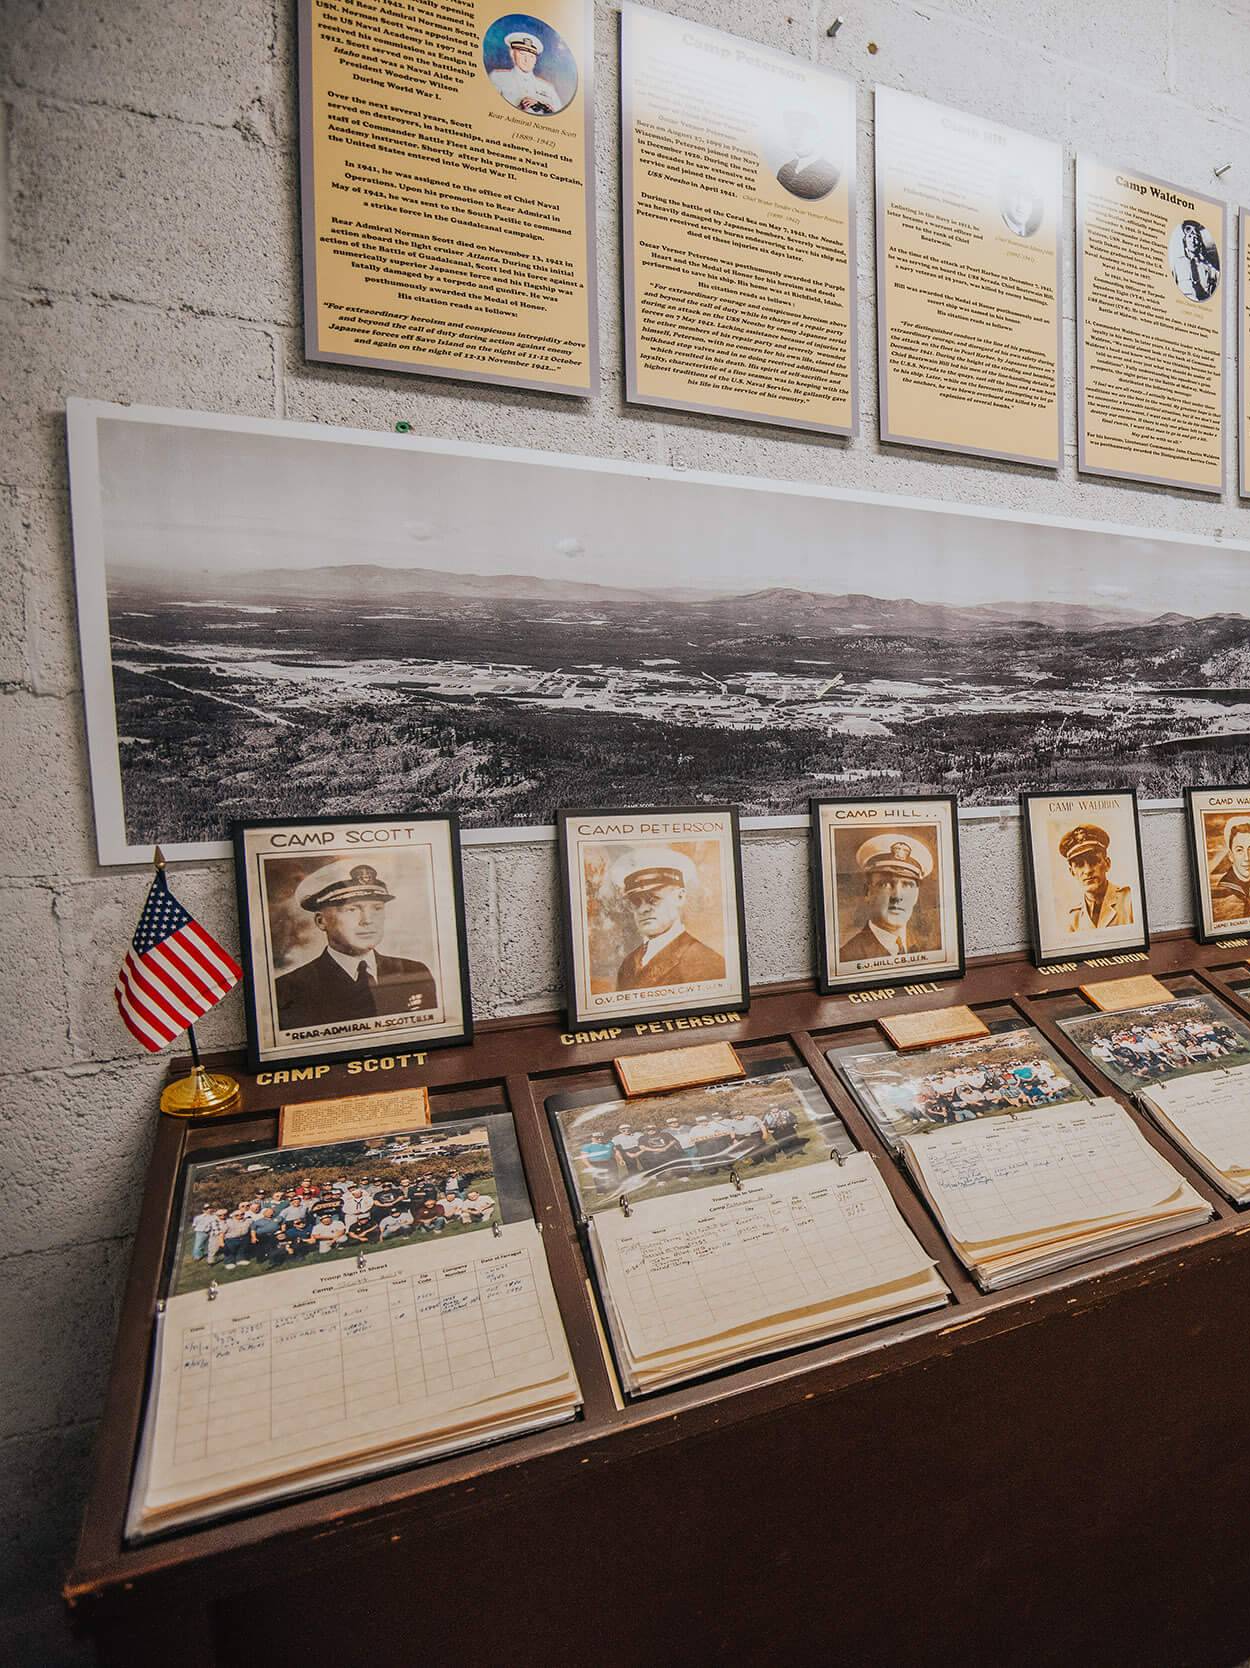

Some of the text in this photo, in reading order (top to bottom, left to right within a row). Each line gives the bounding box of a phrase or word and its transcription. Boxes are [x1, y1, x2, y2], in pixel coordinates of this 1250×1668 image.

[322, 12, 473, 57] the US Naval Academy in 1907 and
[338, 57, 459, 93] President Woodrow Wilson
[352, 73, 442, 101] During World War I.
[487, 111, 577, 138] Rear Admiral Norman Scott
[327, 123, 583, 187] Academy instructor. Shortly after his promotion to Captain,
[647, 170, 662, 178] USS
[663, 174, 690, 185] Neosho
[699, 183, 718, 192] April
[720, 189, 737, 198] 1941.
[1115, 176, 1196, 211] Camp Waldron
[686, 230, 702, 238] died
[712, 236, 730, 244] these
[732, 240, 758, 251] injuries
[770, 249, 785, 257] days
[786, 252, 803, 262] later.
[639, 240, 660, 250] Oscar
[661, 244, 686, 255] Verner
[688, 251, 718, 262] Peterson
[734, 262, 781, 277] posthumously
[783, 274, 811, 283] awarded
[824, 282, 845, 291] Purple
[397, 291, 412, 300] His
[413, 295, 448, 306] citation
[449, 302, 473, 310] reads
[484, 306, 518, 318] follows:
[834, 809, 878, 820] CAMP
[1048, 799, 1120, 813] CAMP WALDRON
[1208, 798, 1233, 806] CAMP
[270, 828, 415, 848] CAMP SCOTT
[577, 822, 724, 836] CAMP PETERSON
[1215, 937, 1249, 951] CAMP
[1037, 952, 1150, 976] CAMP WALDRON
[848, 981, 945, 1005] CAMP HILL
[559, 1012, 742, 1046] CAMP PETERSON
[255, 1052, 429, 1086] CAMP SCOTT
